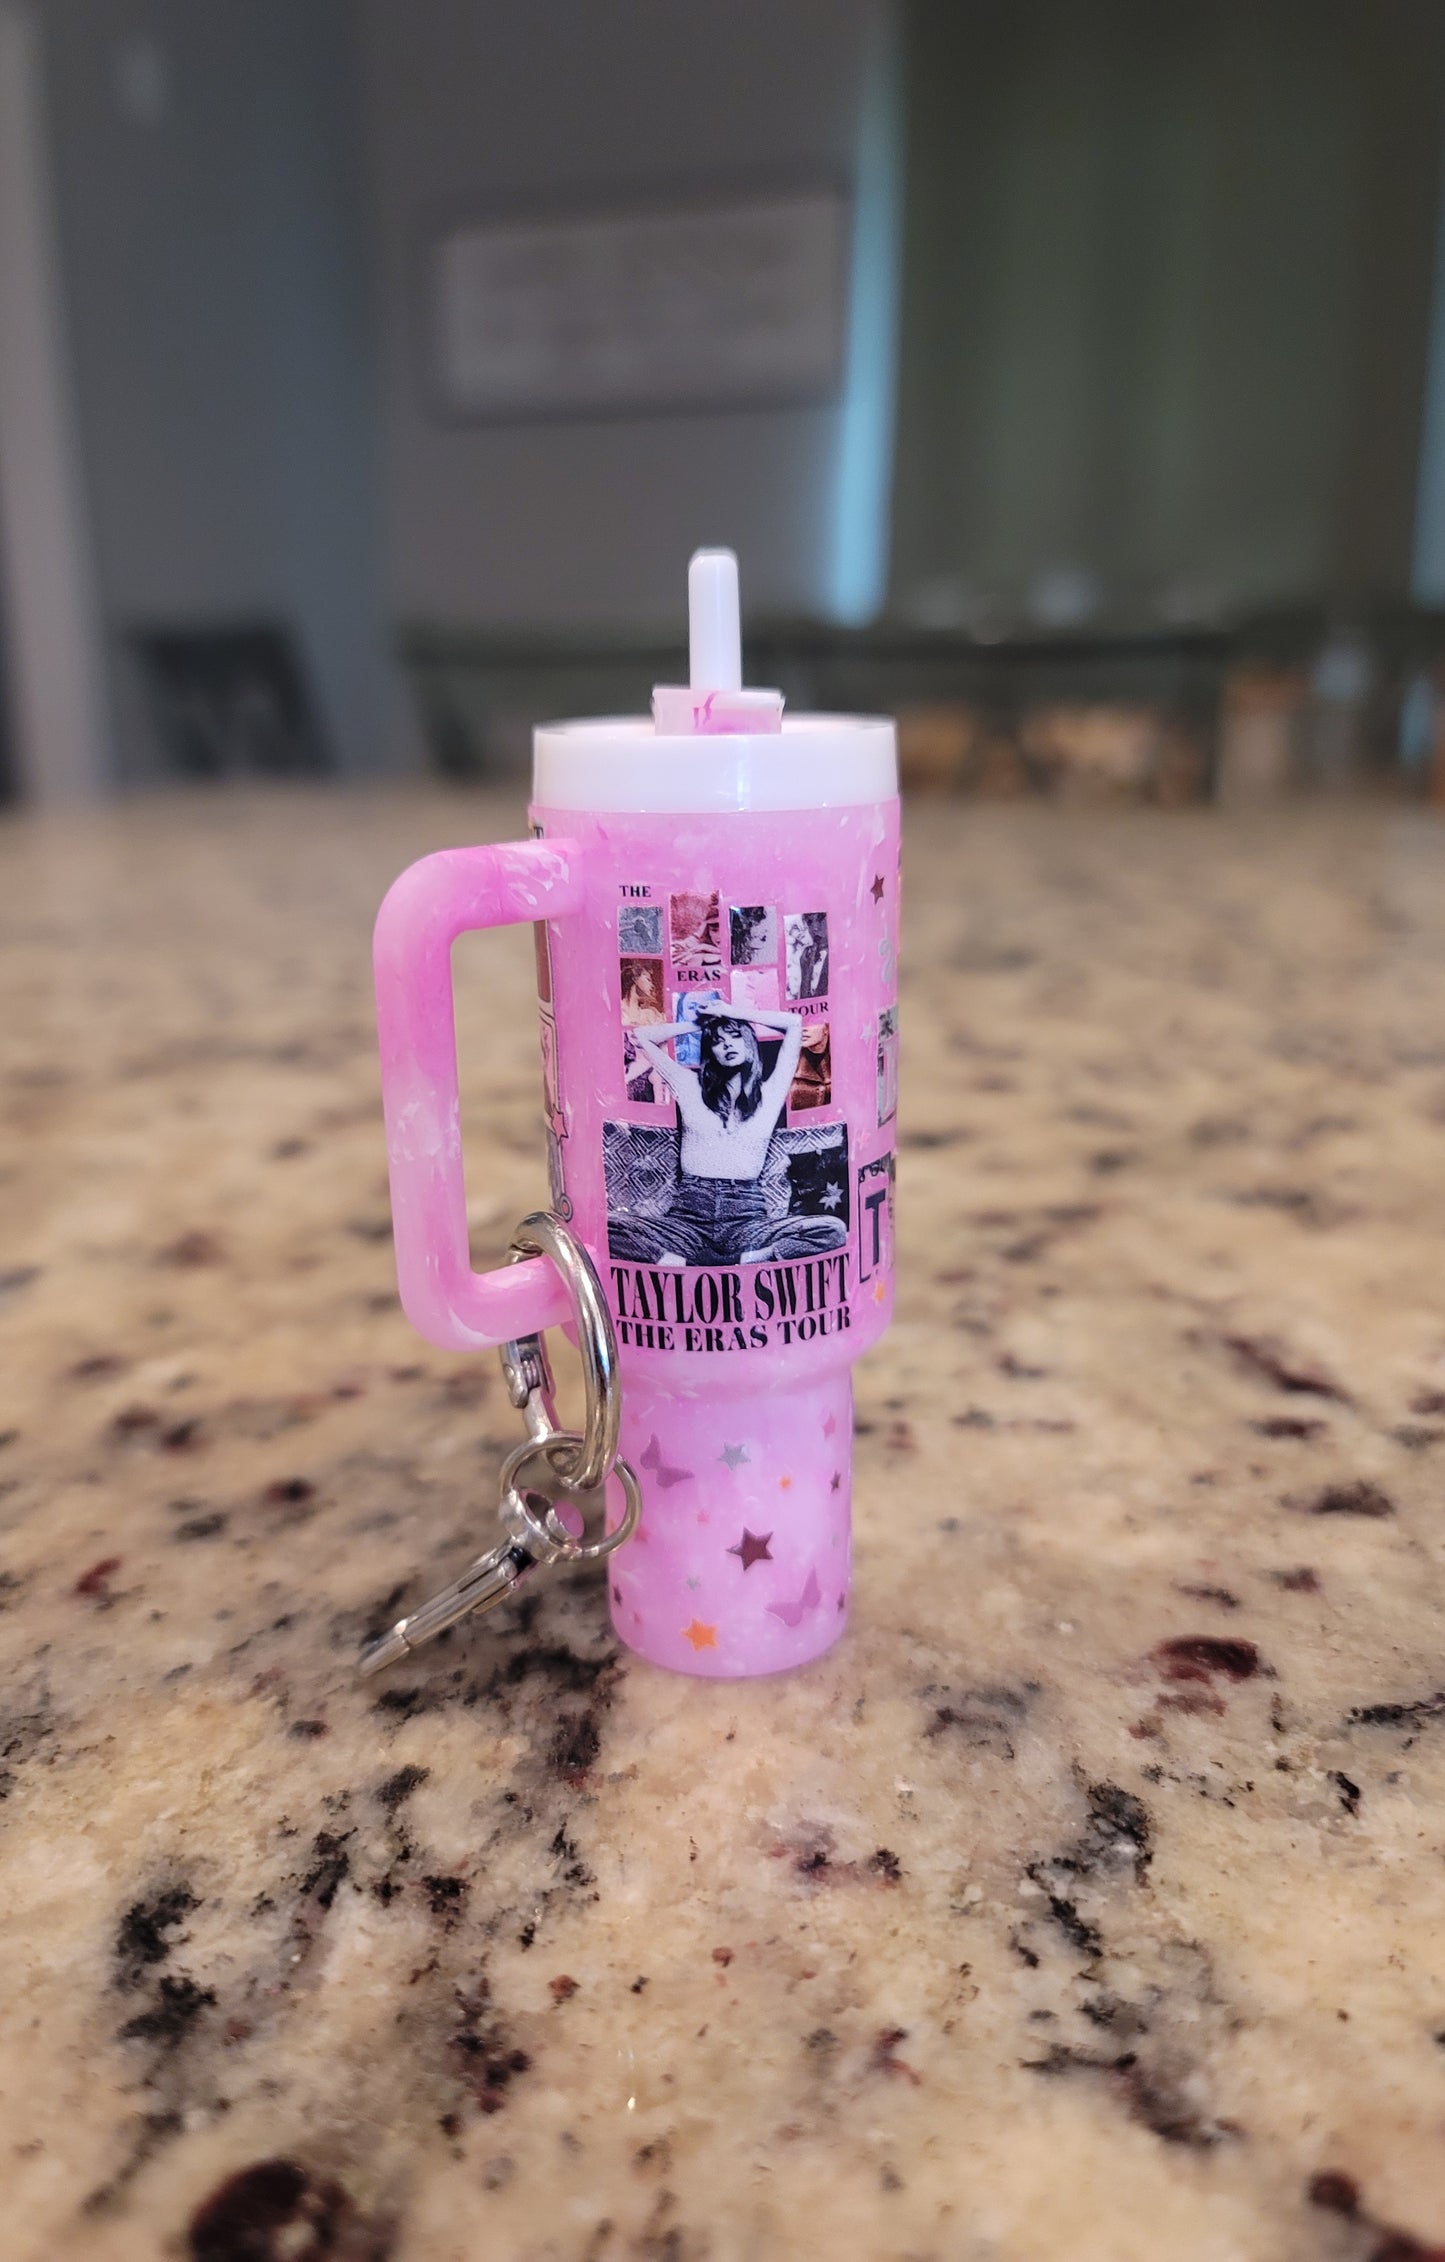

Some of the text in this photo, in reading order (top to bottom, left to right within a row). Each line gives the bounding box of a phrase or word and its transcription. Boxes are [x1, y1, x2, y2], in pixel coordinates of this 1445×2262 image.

[619, 885, 652, 898] THE
[677, 969, 722, 983] ERAS
[610, 1252, 850, 1324] TAYLOR SWIFT
[616, 1305, 851, 1352] THE ERAS TOUR
